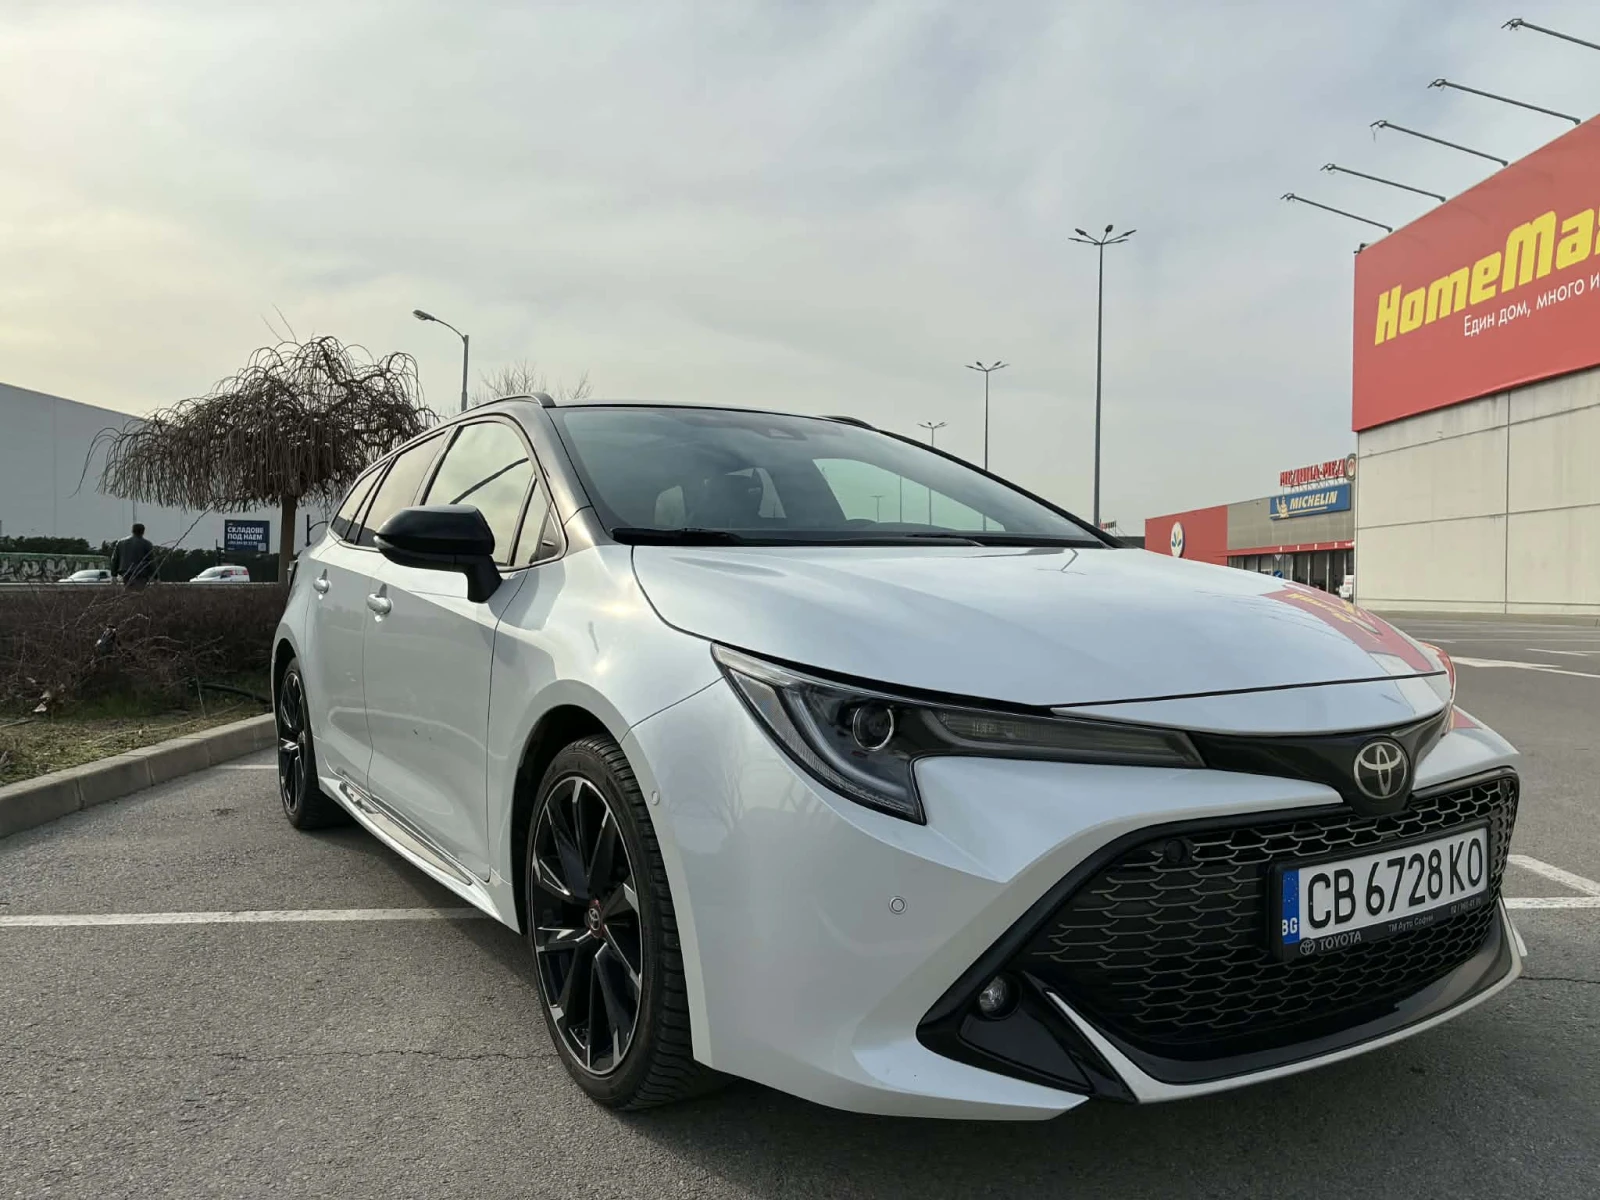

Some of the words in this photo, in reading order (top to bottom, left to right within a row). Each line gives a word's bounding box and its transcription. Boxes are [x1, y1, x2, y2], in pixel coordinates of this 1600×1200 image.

[1375, 206, 1600, 346] HomeMa
[1464, 311, 1495, 337] Един
[1498, 299, 1531, 327] дом,
[1536, 279, 1584, 310] много
[1290, 490, 1338, 510] MICHELIN
[1307, 868, 1356, 929] CB
[1365, 848, 1443, 917] 6728
[1450, 837, 1483, 895] KO
[1282, 917, 1298, 937] BG
[1319, 930, 1362, 951] TOYOTA
